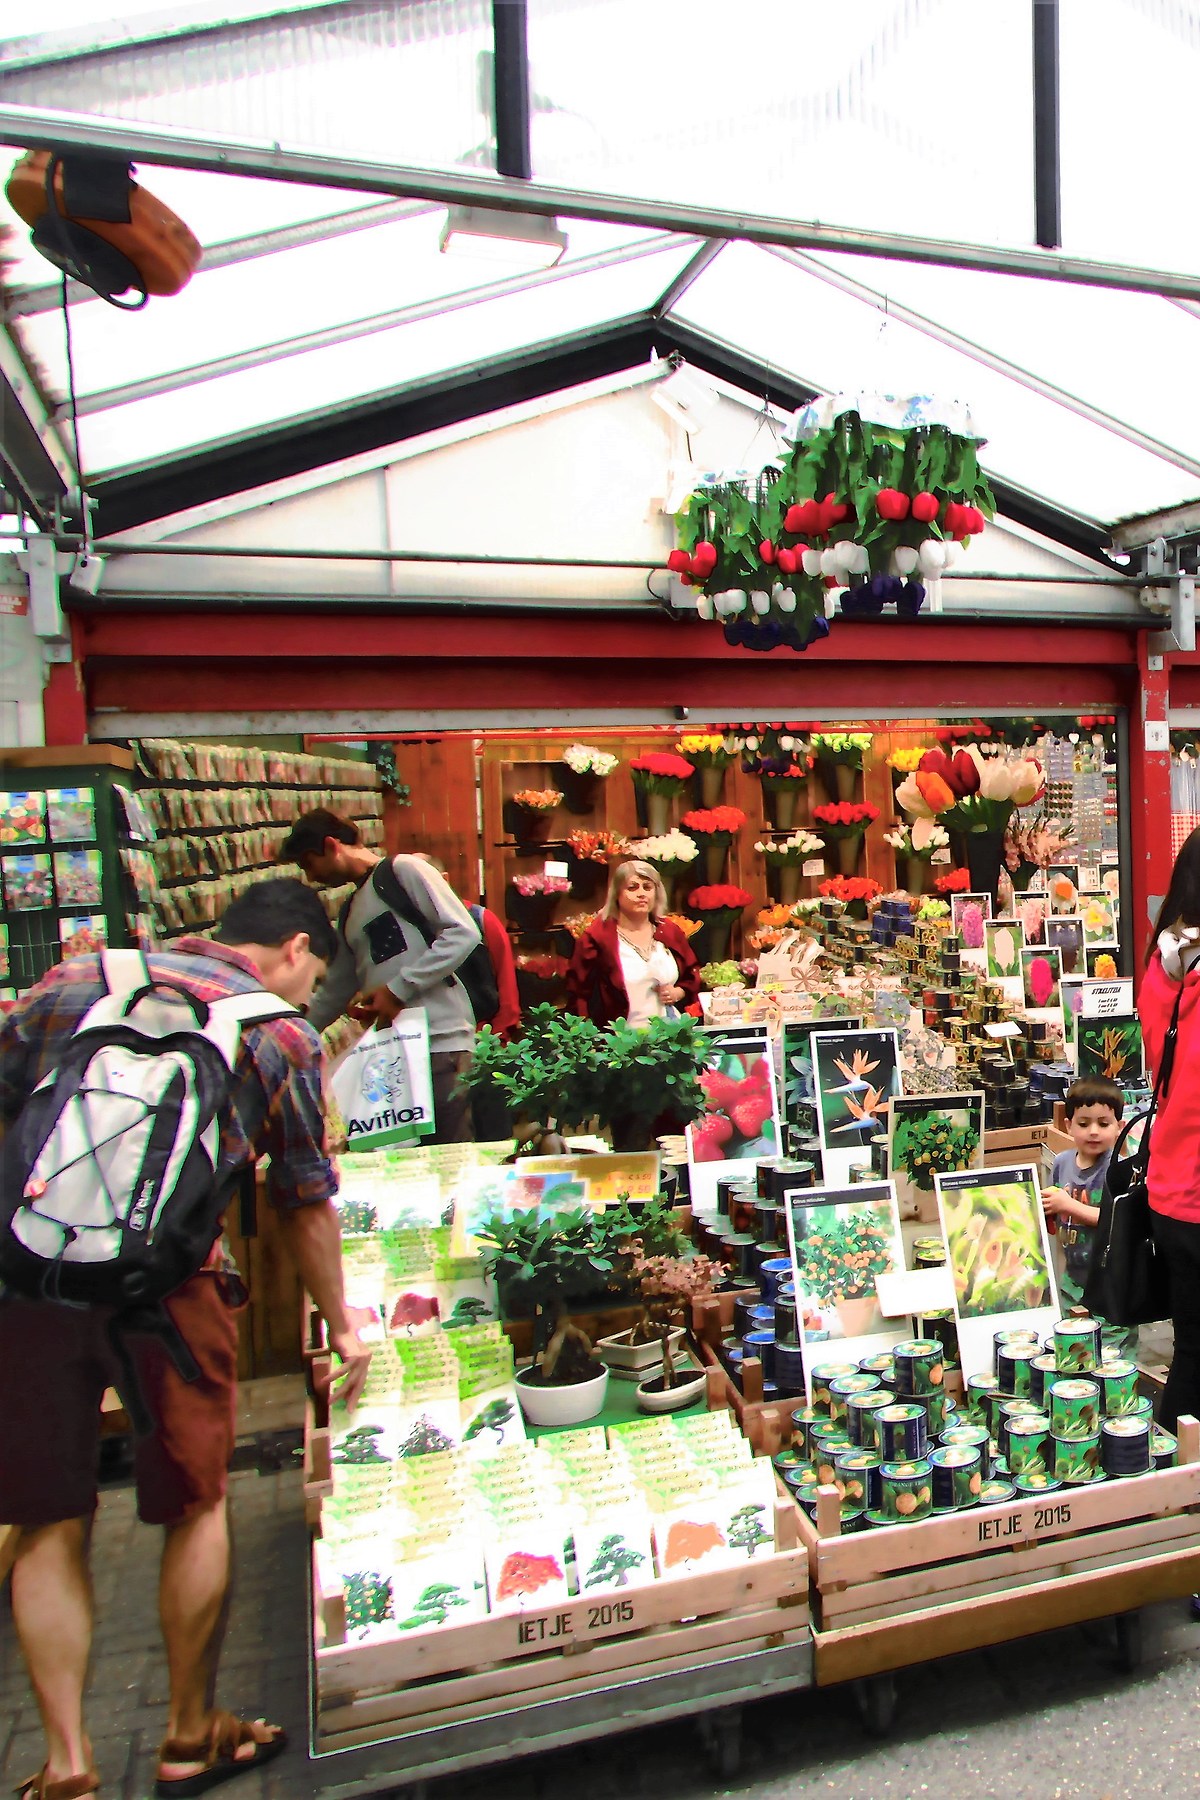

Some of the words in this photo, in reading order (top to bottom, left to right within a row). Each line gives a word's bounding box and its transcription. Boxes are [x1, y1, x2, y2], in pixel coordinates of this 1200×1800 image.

[979, 1513, 1023, 1542] IETJE
[1034, 1503, 1071, 1529] 2015
[518, 1612, 574, 1644] IETJE
[588, 1600, 634, 1630] 2015
